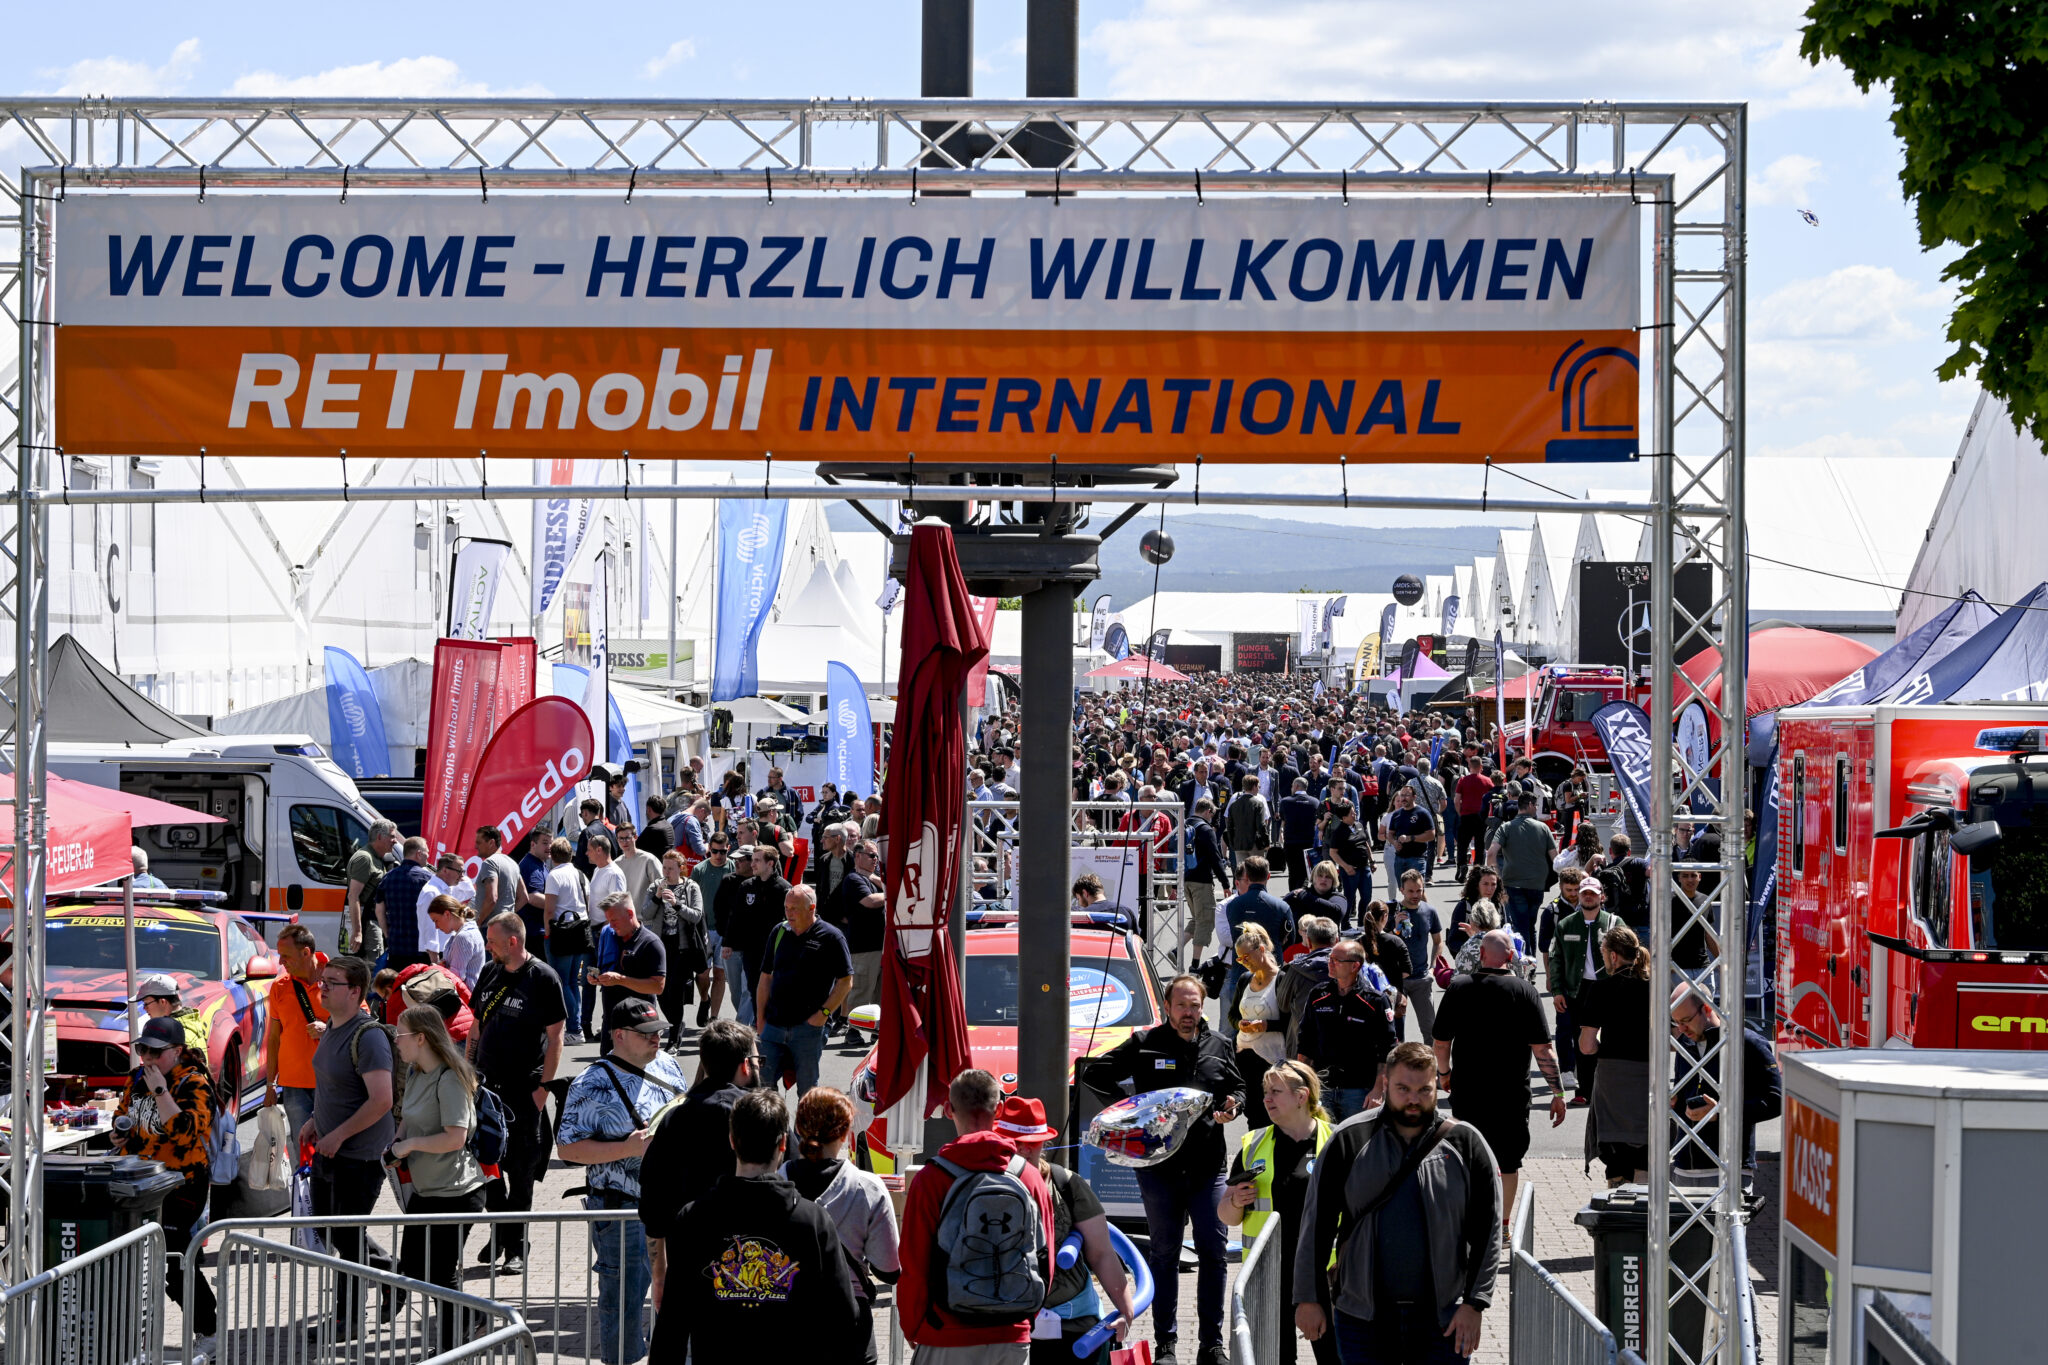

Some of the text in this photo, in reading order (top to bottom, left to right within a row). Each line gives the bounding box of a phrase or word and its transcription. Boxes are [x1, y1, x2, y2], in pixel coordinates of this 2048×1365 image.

[107, 233, 516, 299] WELCOME
[585, 235, 996, 300] HERZLICH
[1028, 237, 1594, 302] WILLKOMMEN
[227, 348, 1463, 436] RETTmobil INTERNATIONAL
[750, 563, 767, 618] victron
[441, 658, 464, 829] conversions without limits
[1971, 1015, 2048, 1034] ern
[1793, 1134, 1833, 1217] KASSE
[717, 1289, 787, 1300] Weasel's Pizza
